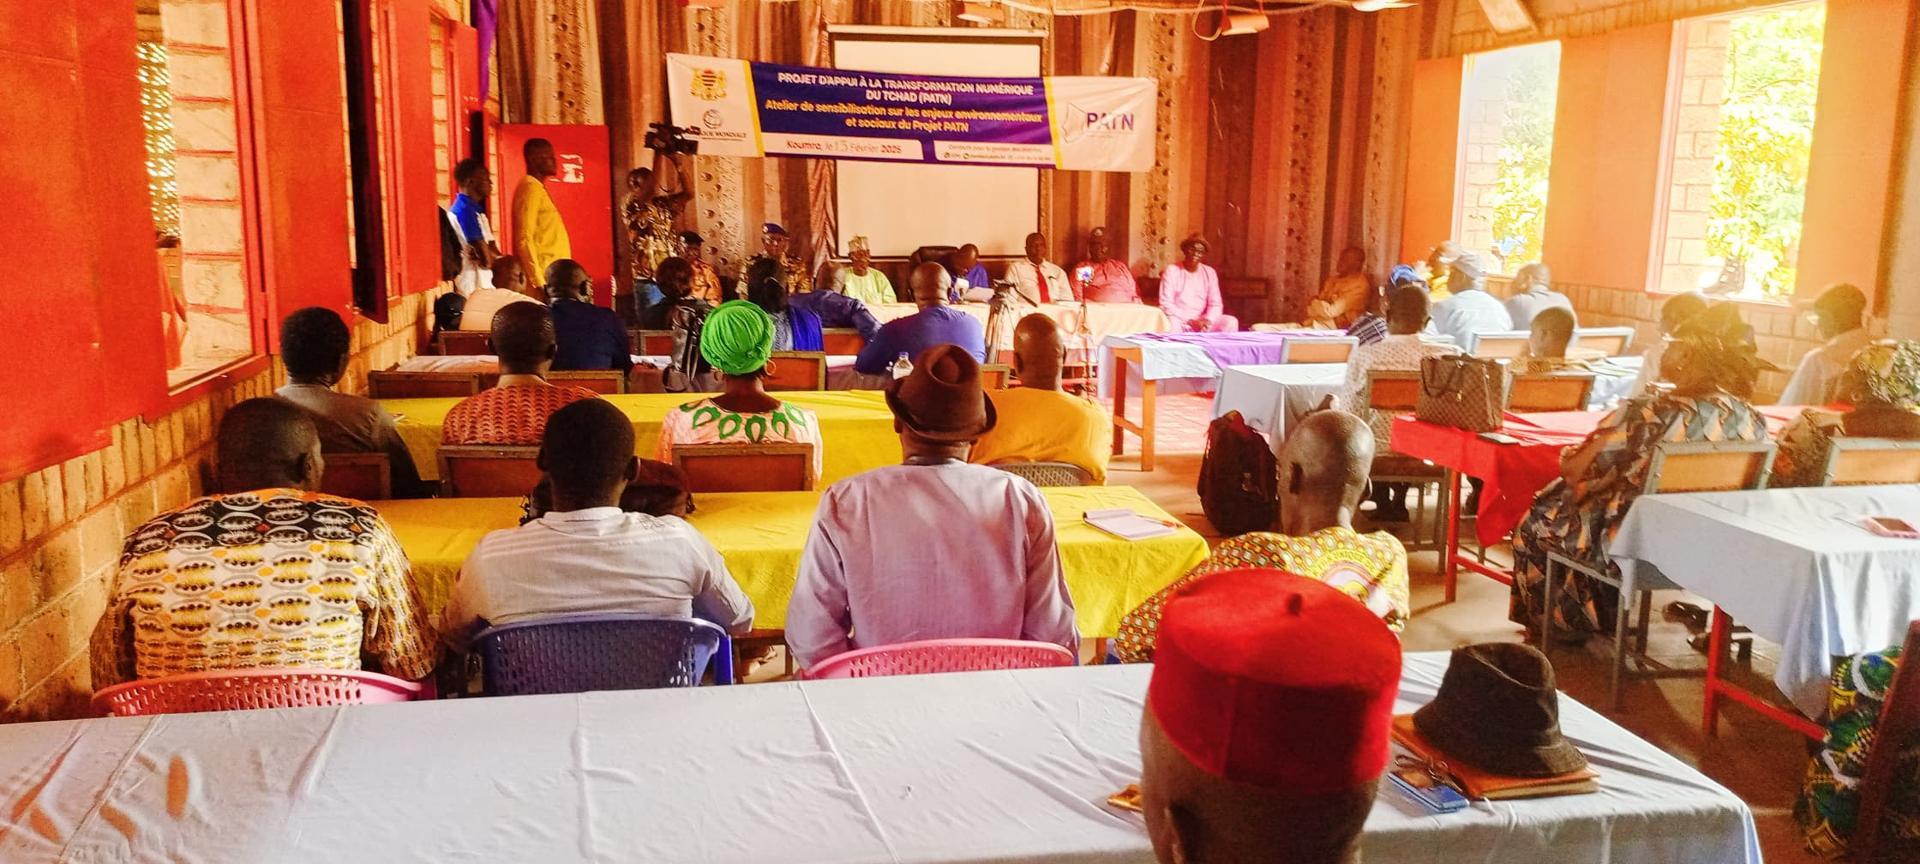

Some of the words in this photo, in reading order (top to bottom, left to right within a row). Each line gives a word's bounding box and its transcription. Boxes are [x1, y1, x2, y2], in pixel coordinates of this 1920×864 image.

[778, 72, 817, 84] PROJET
[819, 75, 858, 87] D'APPUI
[859, 75, 868, 87] À
[869, 78, 882, 89] LA
[884, 79, 975, 93] TRANSFORMATION
[976, 82, 1034, 96] NUMÉRIQUE
[866, 90, 881, 100] DU
[882, 91, 918, 103] TCHAD
[919, 92, 952, 106] (PATN)
[765, 99, 799, 111] Atelier
[800, 101, 814, 112] de
[815, 102, 886, 116] sensibilisation
[888, 108, 904, 117] sur
[905, 107, 920, 117] les
[921, 109, 954, 121] enjeux
[955, 110, 1042, 123] environnementaux
[845, 118, 857, 128] et
[858, 119, 897, 130] sociaux
[898, 119, 911, 130] du
[912, 120, 942, 133] Projet
[943, 122, 969, 133] PATN
